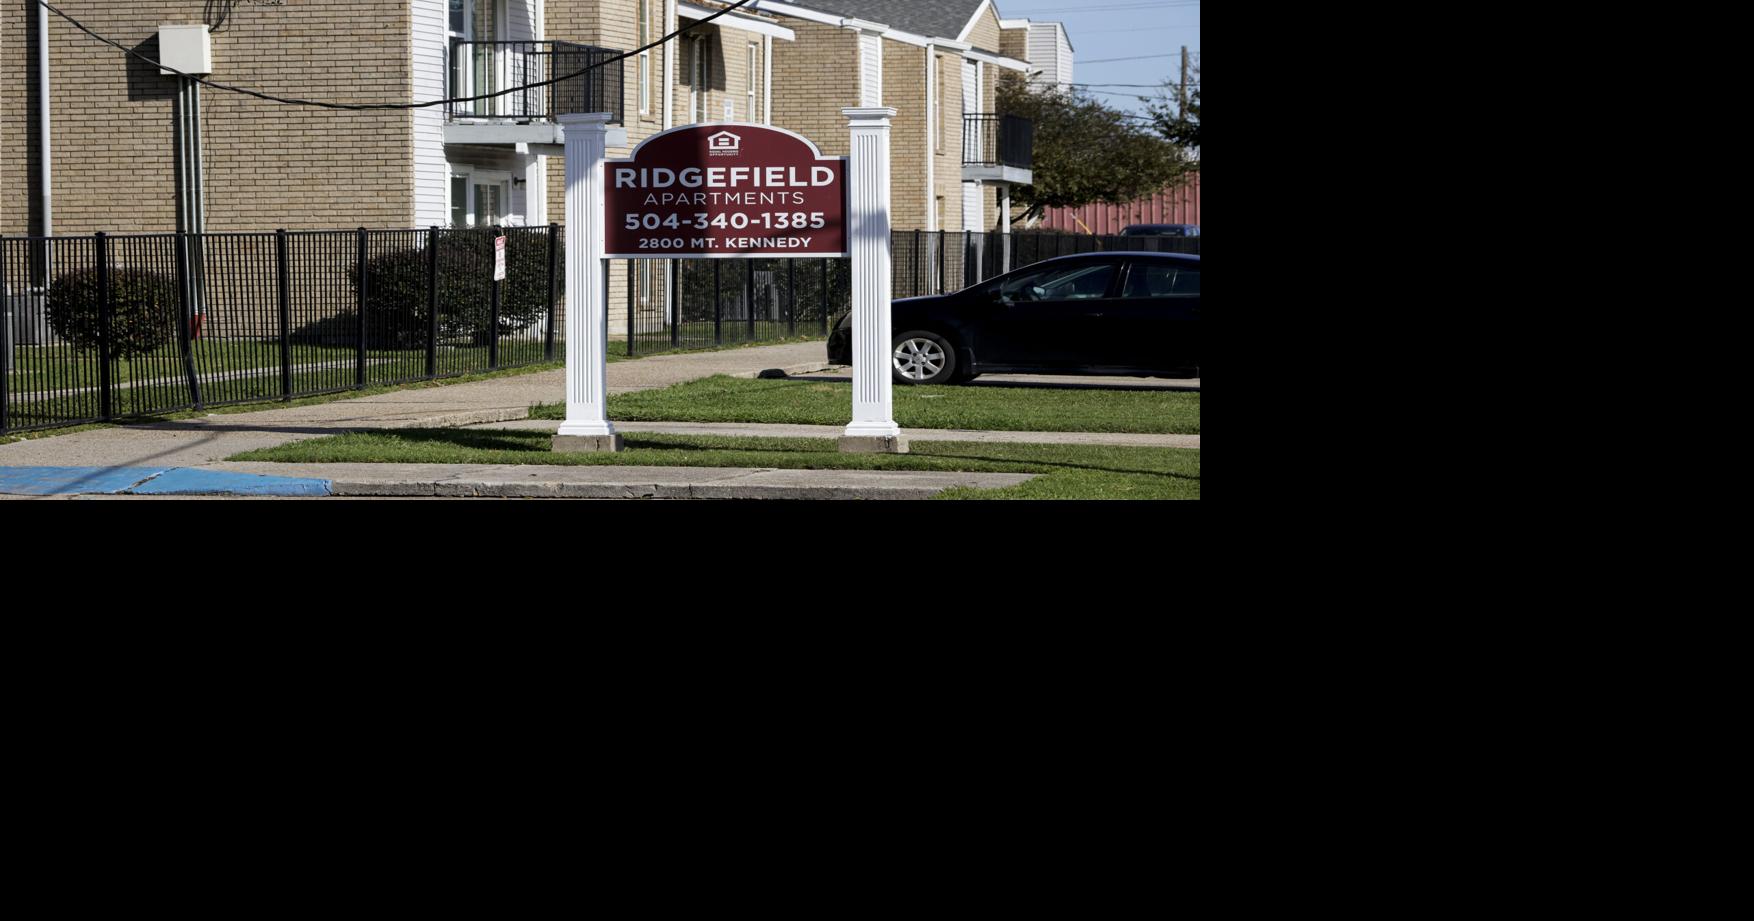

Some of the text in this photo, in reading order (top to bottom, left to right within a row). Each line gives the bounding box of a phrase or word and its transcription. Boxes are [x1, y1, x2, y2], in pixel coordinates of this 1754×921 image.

[615, 166, 835, 188] RIDGEFIELD
[643, 191, 805, 206] APARTMENTS
[625, 212, 825, 230] 504-340-1385
[638, 236, 812, 249] 2800 MT. KENNEDY
